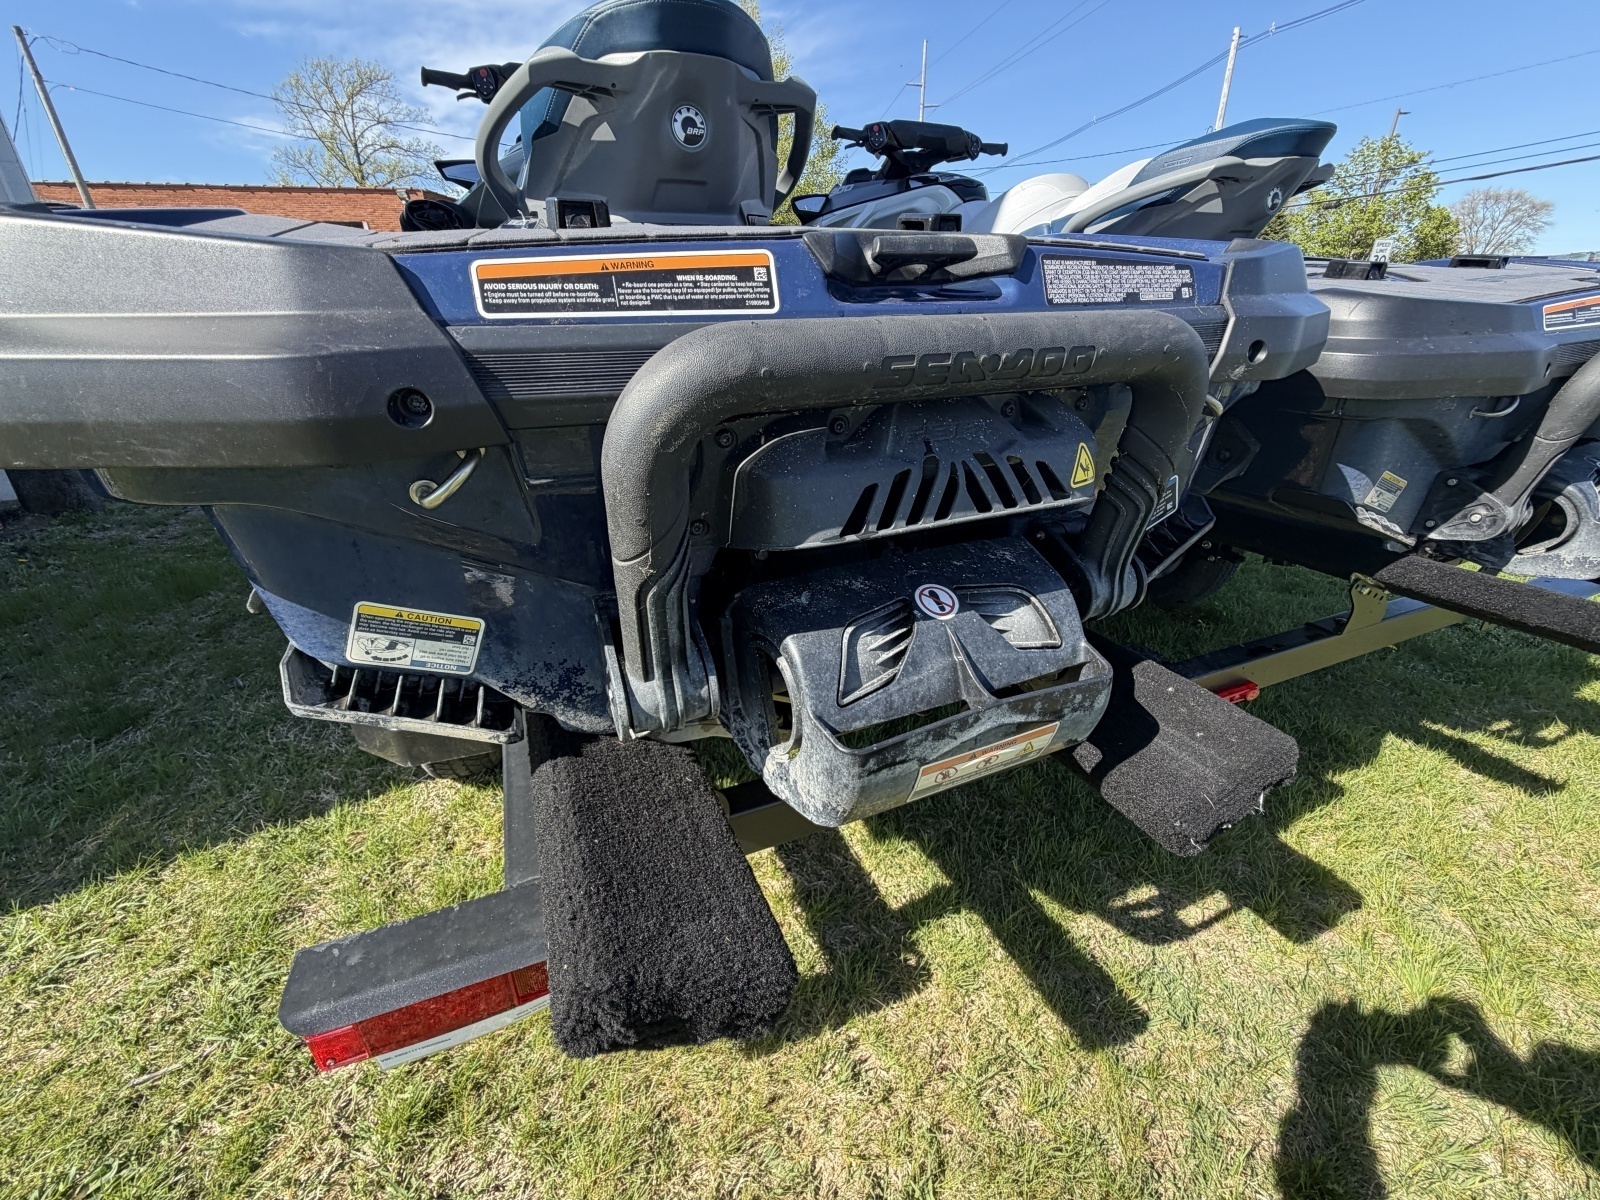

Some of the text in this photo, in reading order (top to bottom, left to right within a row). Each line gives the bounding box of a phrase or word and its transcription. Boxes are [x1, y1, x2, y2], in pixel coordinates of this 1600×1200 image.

[686, 127, 704, 136] BRP
[610, 260, 654, 270] WARNING
[407, 613, 452, 624] CAUTION
[425, 662, 457, 671] NOTICE
[981, 740, 1018, 755] WARNING
